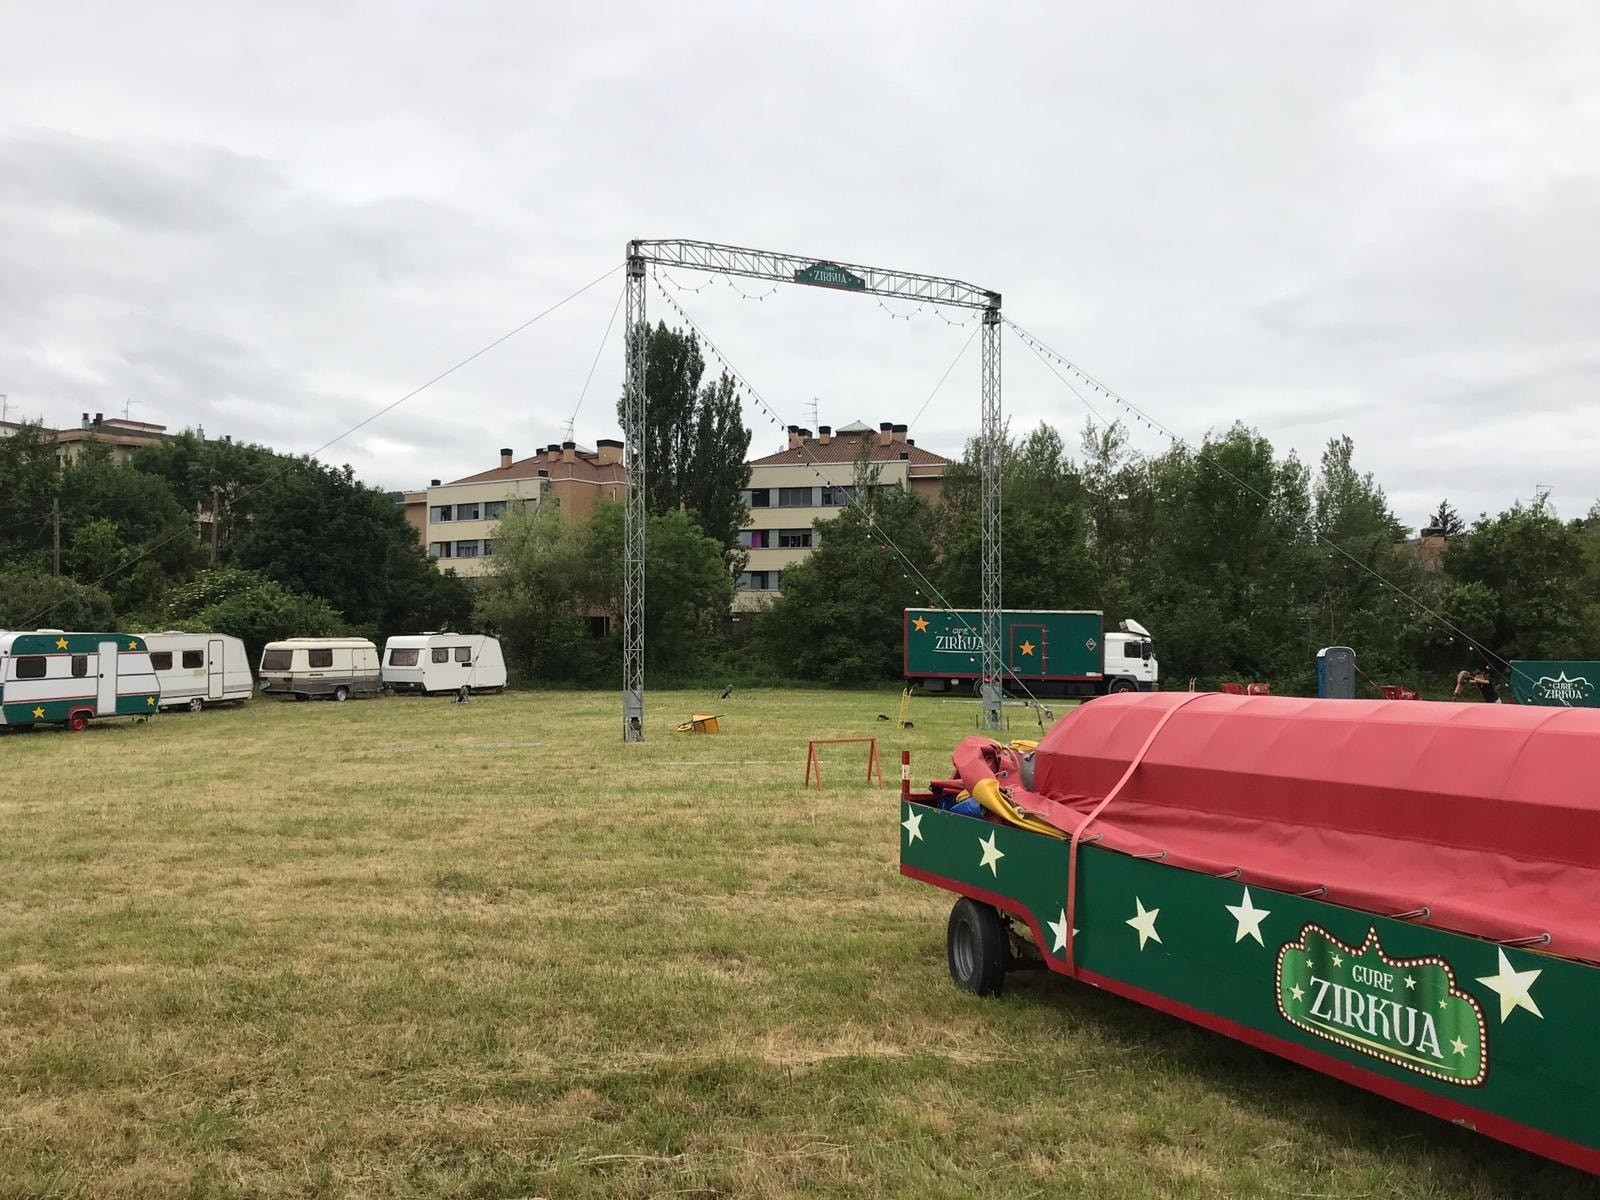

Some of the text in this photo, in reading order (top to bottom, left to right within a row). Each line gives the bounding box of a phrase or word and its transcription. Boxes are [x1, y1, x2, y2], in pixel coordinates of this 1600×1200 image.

[813, 269, 847, 284] ZIRKUA
[935, 635, 985, 650] ZIRKUA
[1544, 689, 1583, 699] ZIRKUA
[1552, 682, 1573, 691] GURE
[1352, 965, 1394, 993] GURE
[1309, 975, 1444, 1059] ZIRKUA
